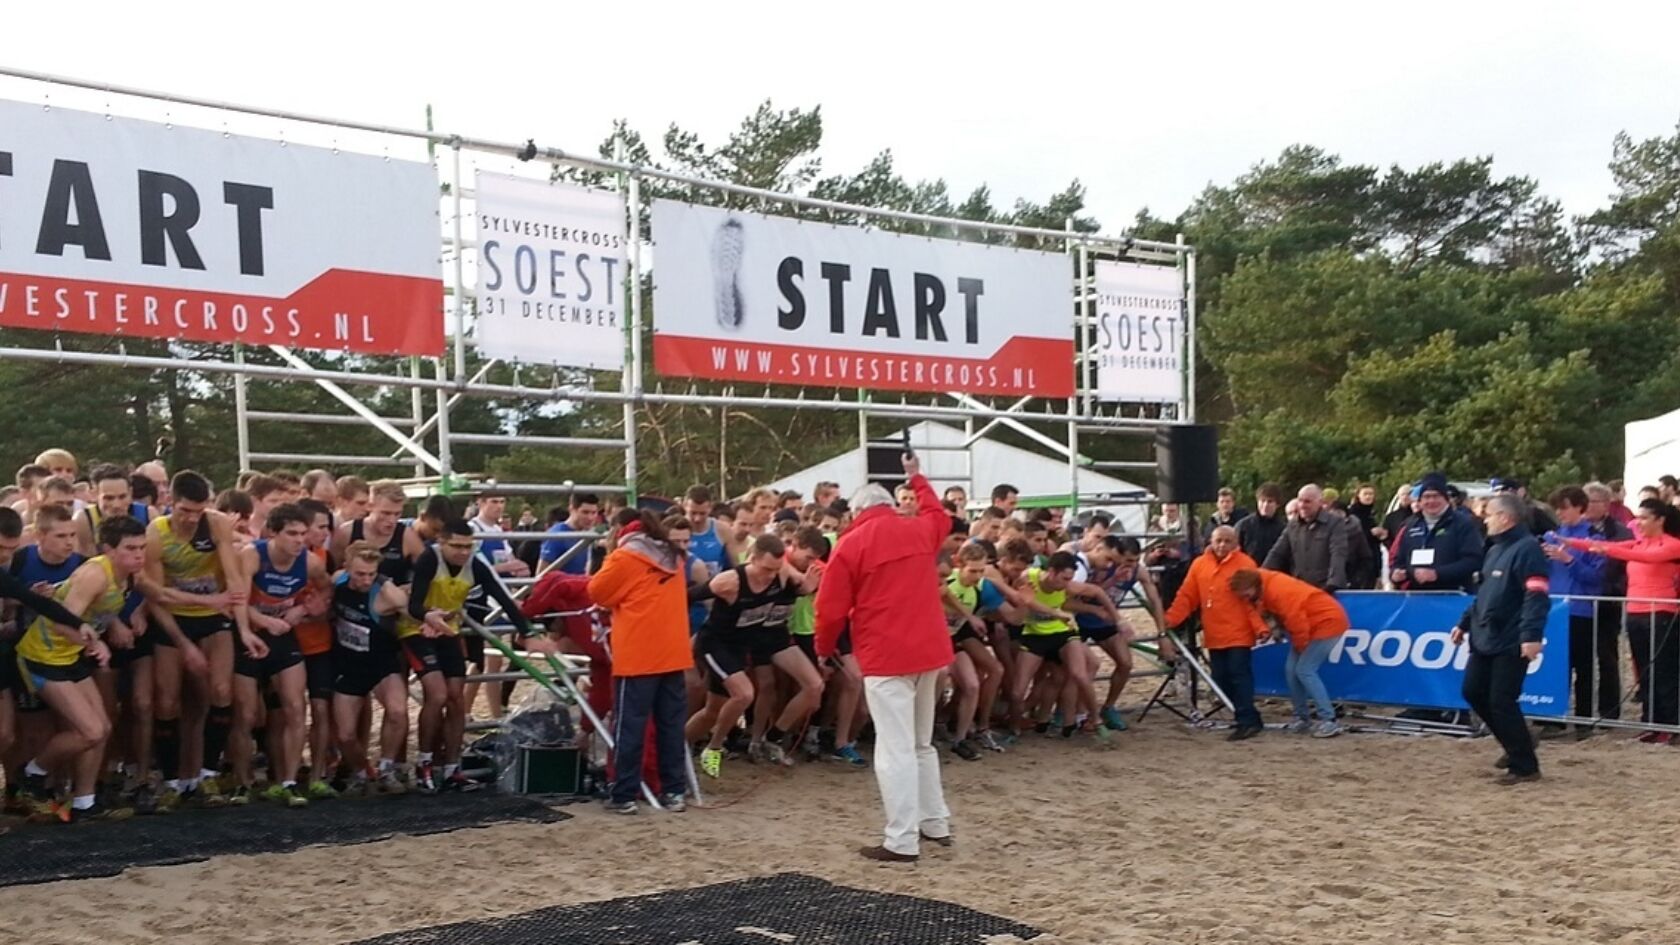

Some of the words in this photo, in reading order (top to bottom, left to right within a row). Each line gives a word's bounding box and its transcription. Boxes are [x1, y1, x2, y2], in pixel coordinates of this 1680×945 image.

[0, 151, 274, 276] ART
[482, 215, 619, 248] SYLVESTERCROSS
[484, 240, 618, 304] SOEST
[486, 297, 505, 315] 31
[522, 301, 616, 327] DECEMBER
[777, 256, 984, 344] START
[1099, 295, 1177, 310] SYLVESTERCROSS
[1101, 312, 1177, 353] SOEST
[712, 346, 1036, 389] WWW.SYLVESTERCROSS.NL
[1122, 356, 1177, 370] DECEMBER
